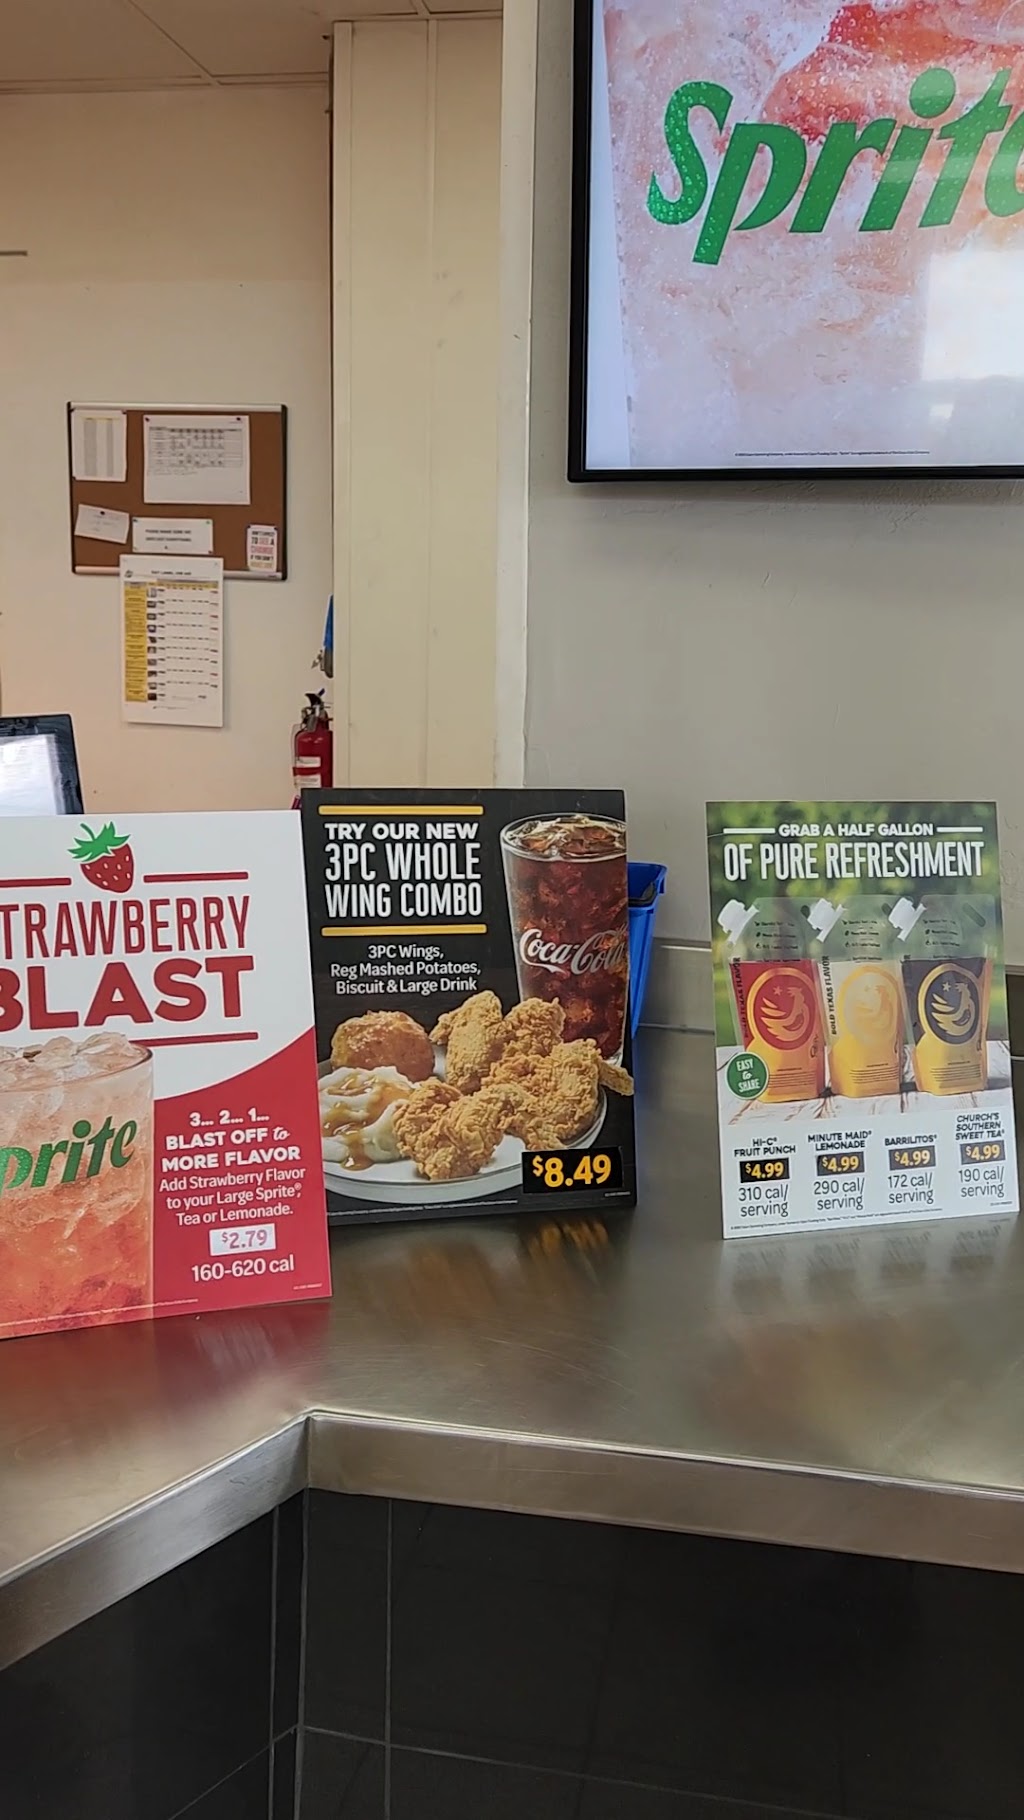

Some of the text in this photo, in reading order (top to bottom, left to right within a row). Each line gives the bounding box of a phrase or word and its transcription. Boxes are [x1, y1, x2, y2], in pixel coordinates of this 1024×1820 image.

[324, 822, 478, 840] TRY OUR NEW
[778, 823, 934, 837] GRAB A HALF GALLON
[325, 842, 481, 881] 3PC WHOLE
[724, 841, 984, 881] OF PURE REFRESHMENT
[325, 882, 482, 917] WING COMBO
[0, 896, 249, 959] TRAWBERRY
[368, 944, 444, 960] 3PC Wings,
[520, 922, 628, 975] Coca-Cola
[331, 961, 481, 980] Reg Mashed Potatoes,
[336, 977, 477, 996] Biscuit & Large Drink
[822, 956, 837, 1035] BOLD TEXAS FLAVOR
[736, 1058, 753, 1071] EASY
[738, 1078, 760, 1092] SHARE
[957, 1112, 999, 1122] CHURCH'S
[956, 1121, 1001, 1131] SOUTHERN
[166, 1127, 290, 1150] BLAST OFF to
[807, 1132, 842, 1142] MINUTE
[955, 1130, 984, 1141] SWEET
[734, 1145, 796, 1157] FRUIT PUNCH
[815, 1140, 866, 1151] LEMONADE
[965, 1144, 1000, 1161] $4.99
[0, 1115, 137, 1195] prite
[162, 1146, 301, 1172] MORE FLAVOR
[822, 1155, 859, 1172] $4.99
[894, 1150, 930, 1166] $4.99
[532, 1154, 612, 1187] $8.49
[745, 1162, 784, 1178] $4.99
[958, 1166, 1004, 1183] 190 cal/
[159, 1168, 306, 1192] Add Strawberry Flavor
[813, 1177, 865, 1195] 290 cal/
[888, 1172, 933, 1188] 172 cal/
[738, 1184, 788, 1201] 310 cal/
[889, 1188, 934, 1204] serving
[961, 1181, 1004, 1198] serving
[166, 1196, 181, 1209] to
[183, 1194, 214, 1210] your
[217, 1190, 253, 1205] Large
[817, 1194, 863, 1211] serving
[176, 1202, 294, 1226] Tea or Lemonade.
[740, 1201, 789, 1217] serving
[222, 1229, 267, 1249] $2.79
[191, 1254, 294, 1282] 160-620 cal
